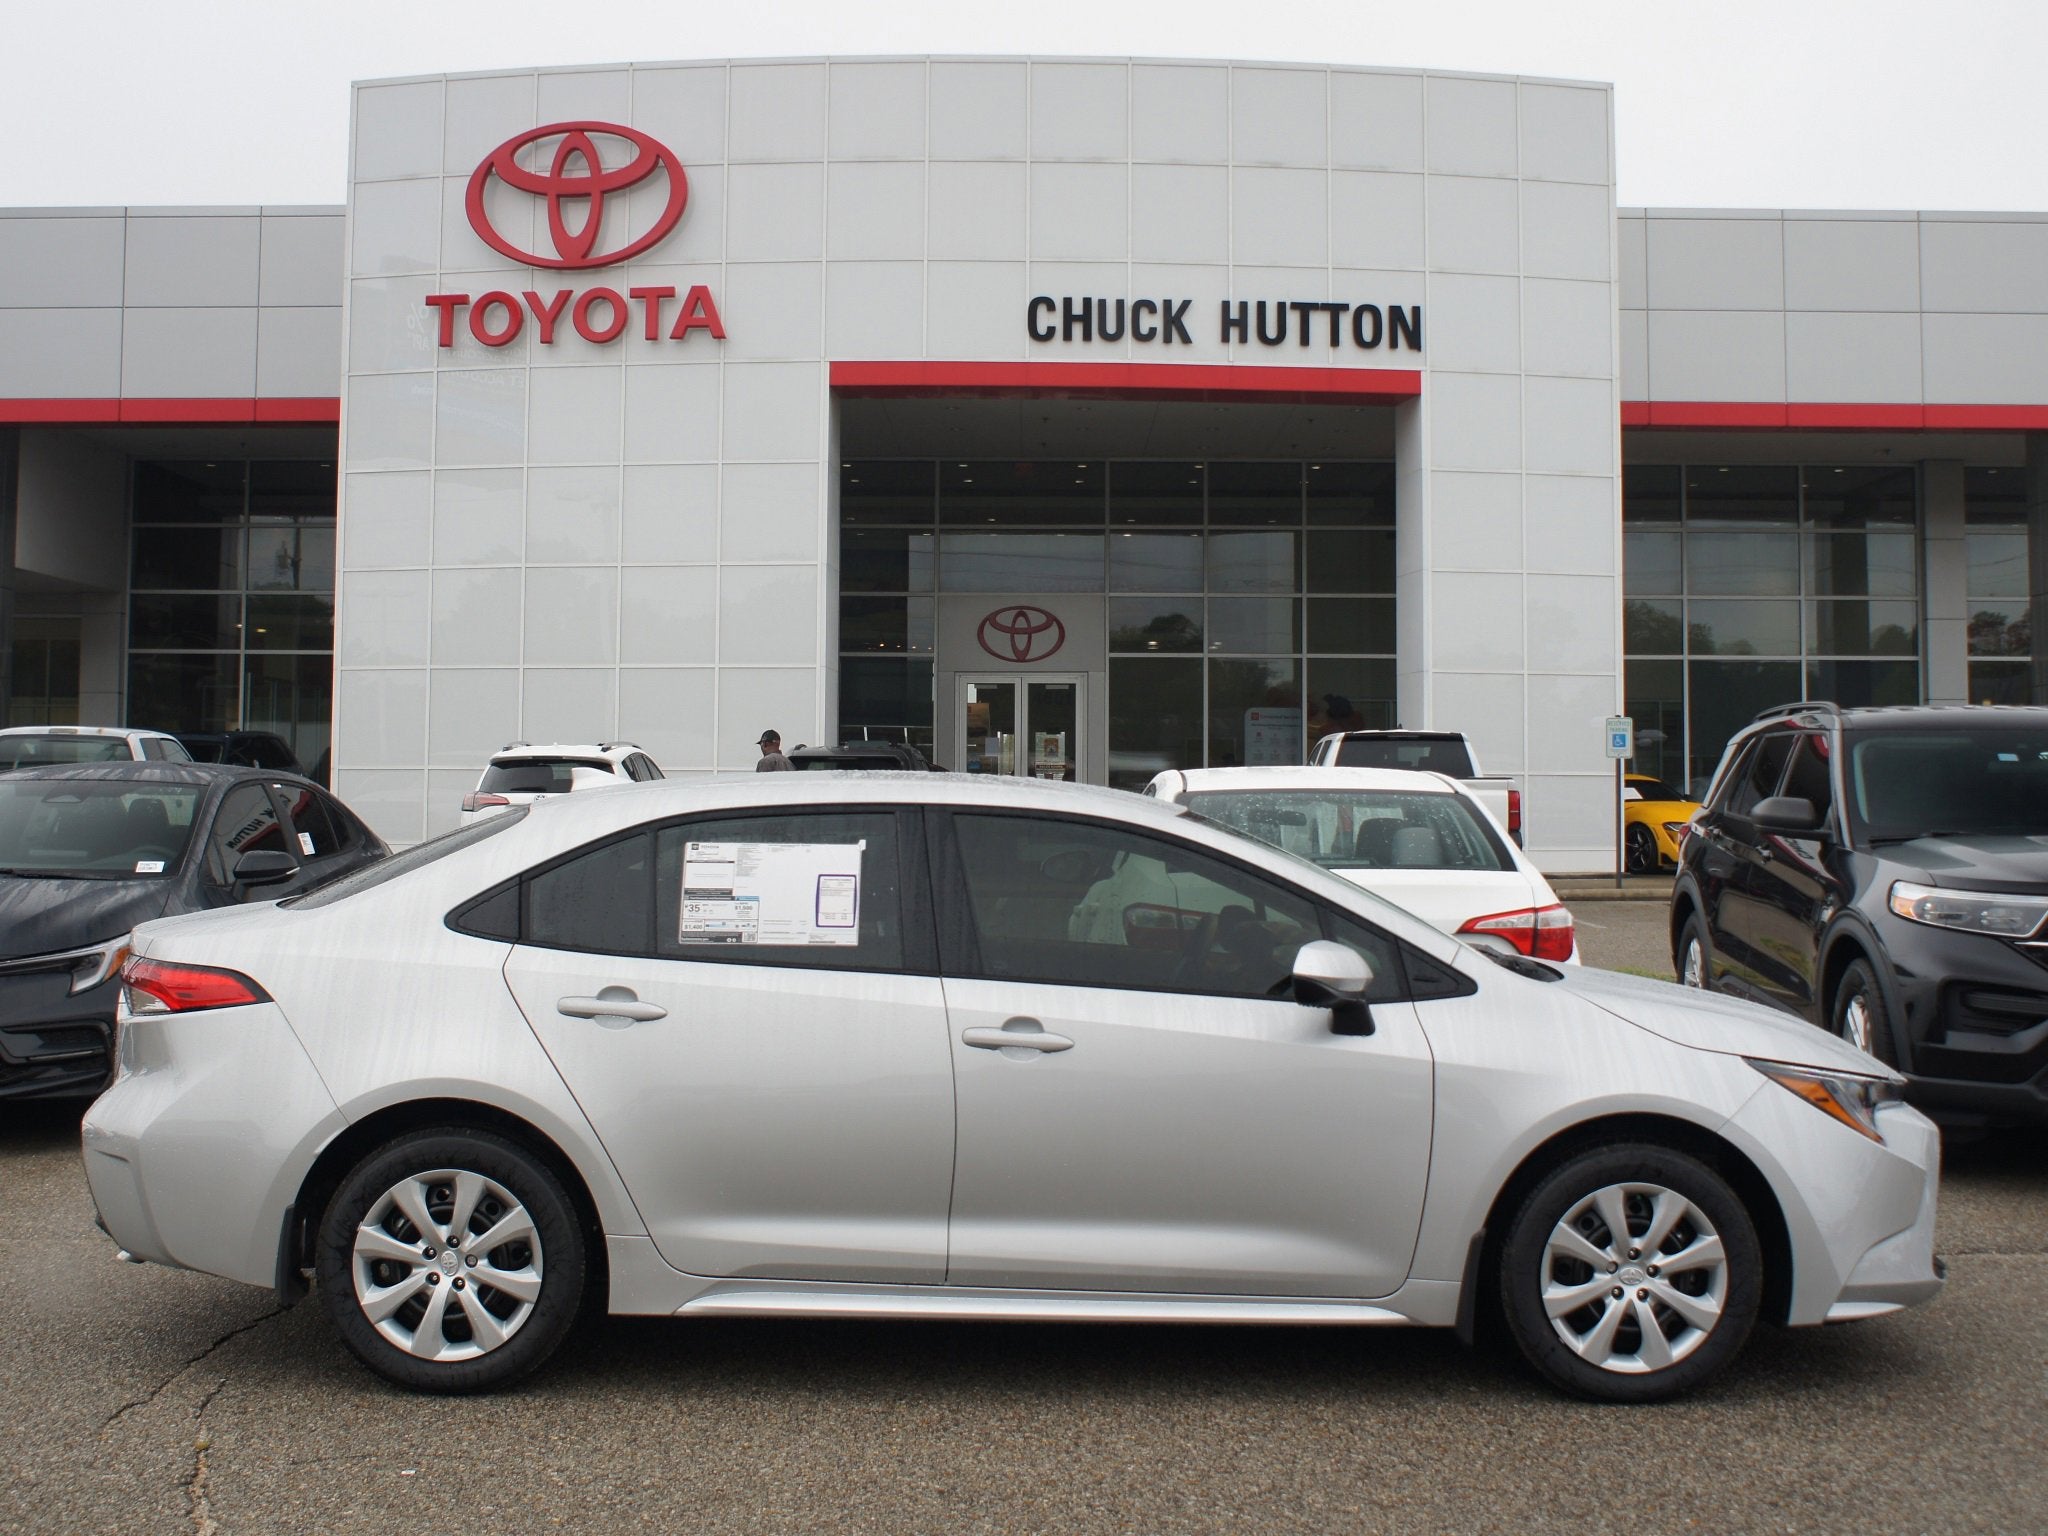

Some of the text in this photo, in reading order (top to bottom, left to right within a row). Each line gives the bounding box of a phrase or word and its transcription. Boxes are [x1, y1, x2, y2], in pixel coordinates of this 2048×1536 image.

[425, 285, 727, 348] TOYOTA
[1027, 296, 1422, 352] CHUCK HUTTON
[688, 904, 701, 912] 35
